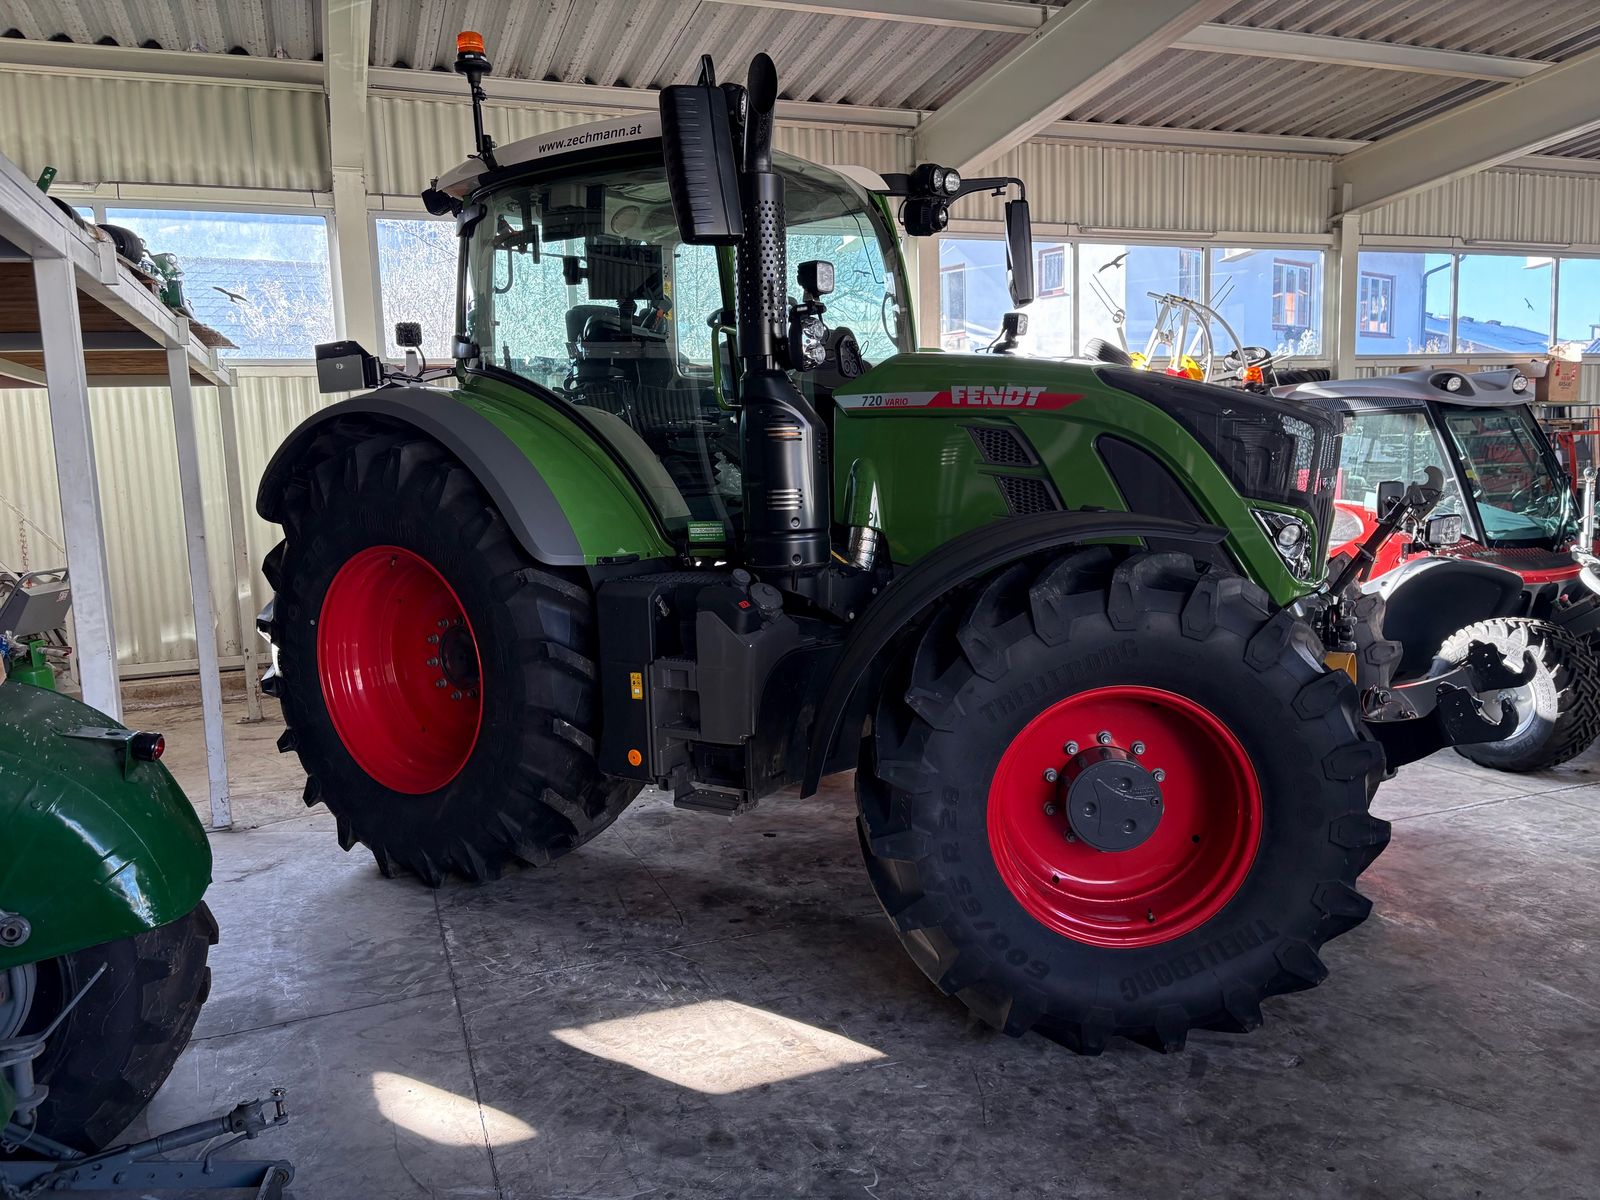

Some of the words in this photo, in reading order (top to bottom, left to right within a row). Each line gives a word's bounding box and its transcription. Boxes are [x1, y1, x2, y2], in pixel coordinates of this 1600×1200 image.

[538, 123, 642, 154] www.zechmann.at
[862, 395, 882, 408] 720
[884, 397, 908, 407] VARIO
[950, 385, 1047, 406] FENDT
